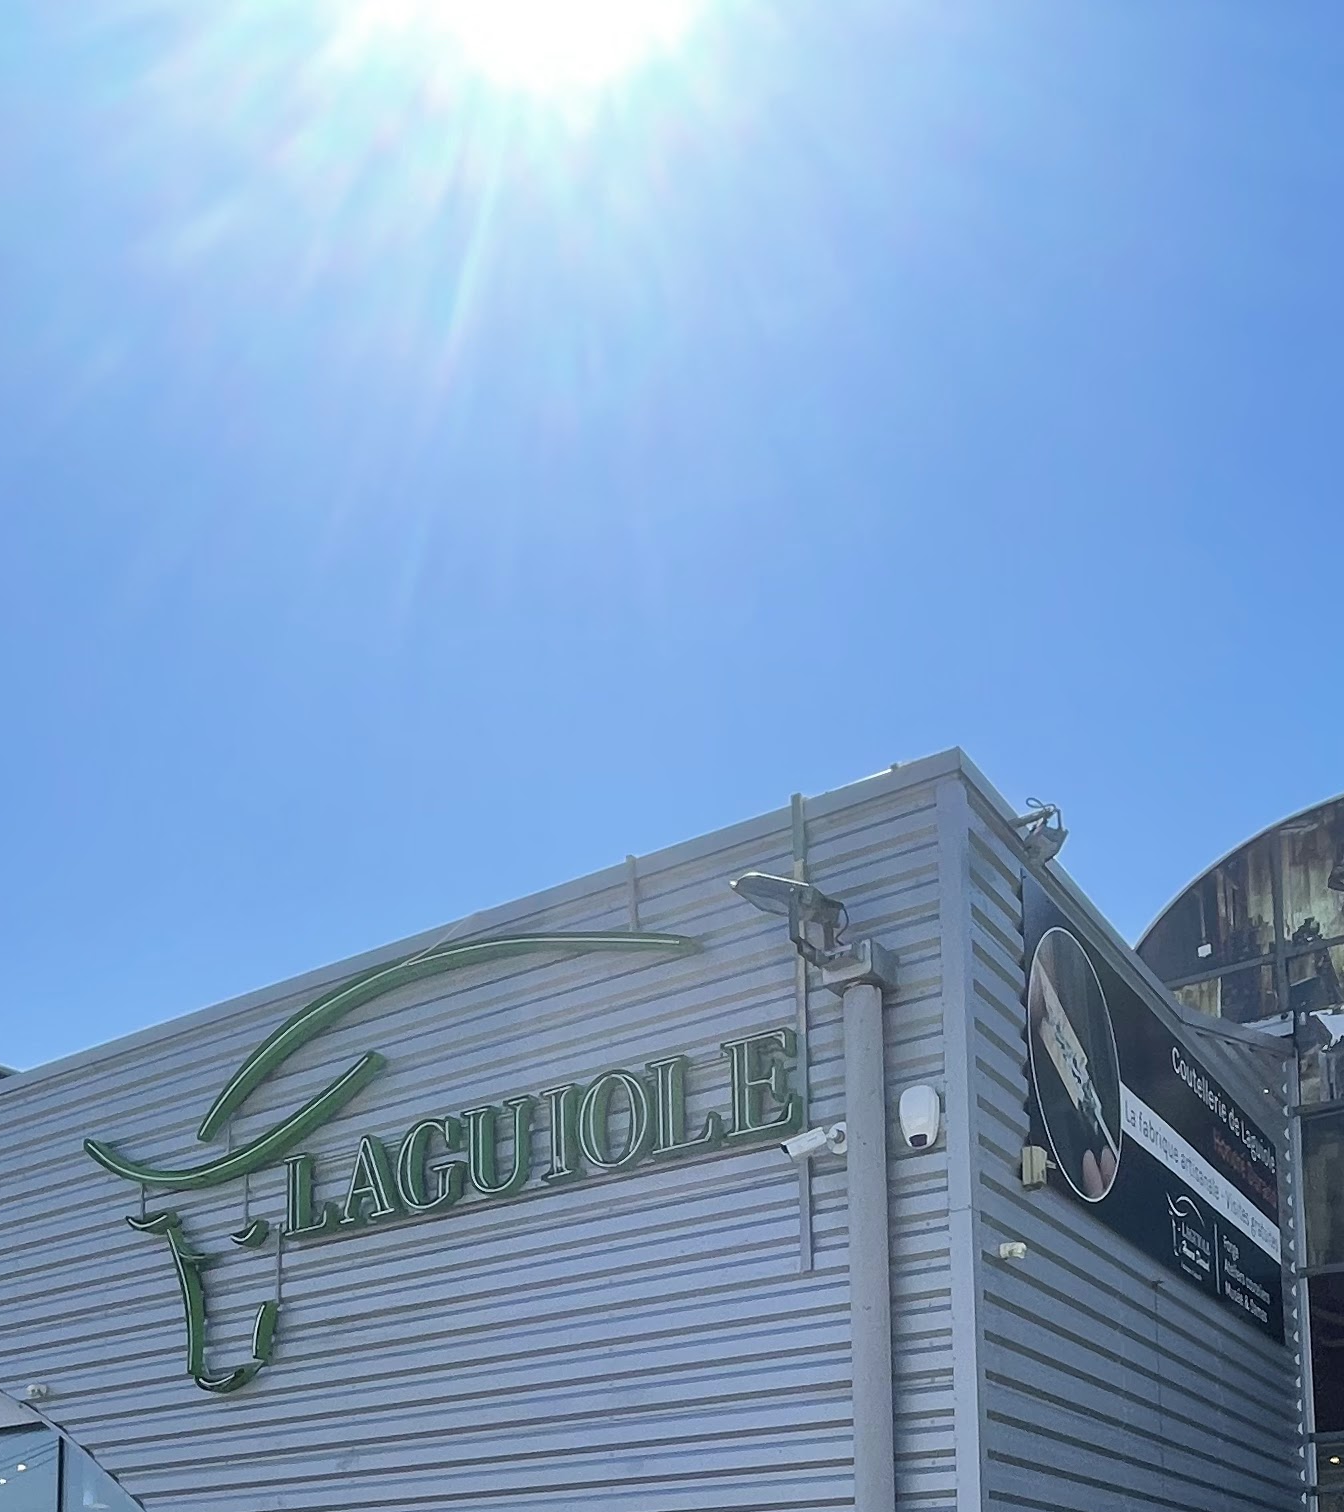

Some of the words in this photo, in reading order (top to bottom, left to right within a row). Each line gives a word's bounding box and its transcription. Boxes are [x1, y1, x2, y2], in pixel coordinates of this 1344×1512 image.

[282, 1026, 803, 1237] LAGUIOLE
[1124, 1100, 1136, 1129] La
[1138, 1107, 1179, 1162] fabrique
[1171, 1046, 1227, 1123] Coutellerie
[1228, 1107, 1240, 1137] de
